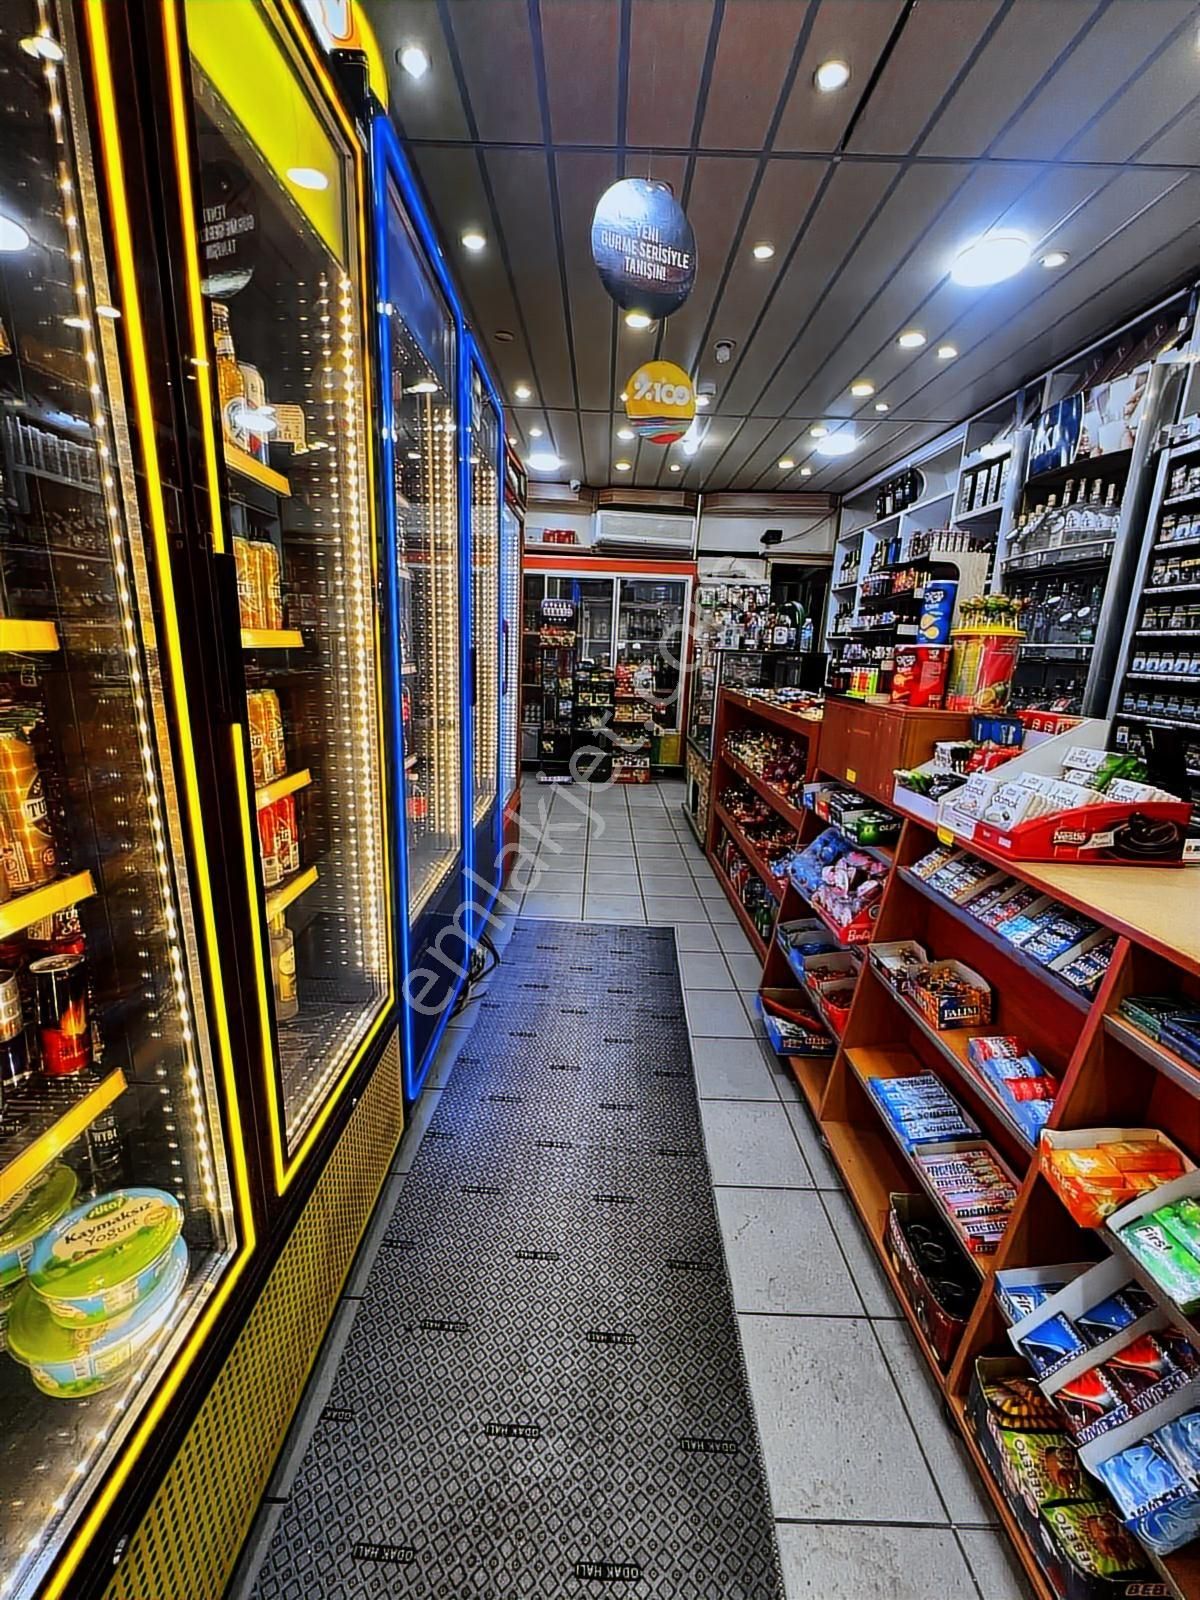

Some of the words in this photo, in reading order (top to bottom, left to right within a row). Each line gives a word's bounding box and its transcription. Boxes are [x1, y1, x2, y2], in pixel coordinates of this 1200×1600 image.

[639, 243, 690, 269] SERİSİYLE
[624, 256, 667, 281] TANIŞIN!
[955, 1204, 1004, 1218] mentos
[966, 1221, 1008, 1234] mento
[1013, 1437, 1047, 1500] BEBETO
[383, 1546, 414, 1562] ODAK
[606, 1567, 640, 1578] ODAK
